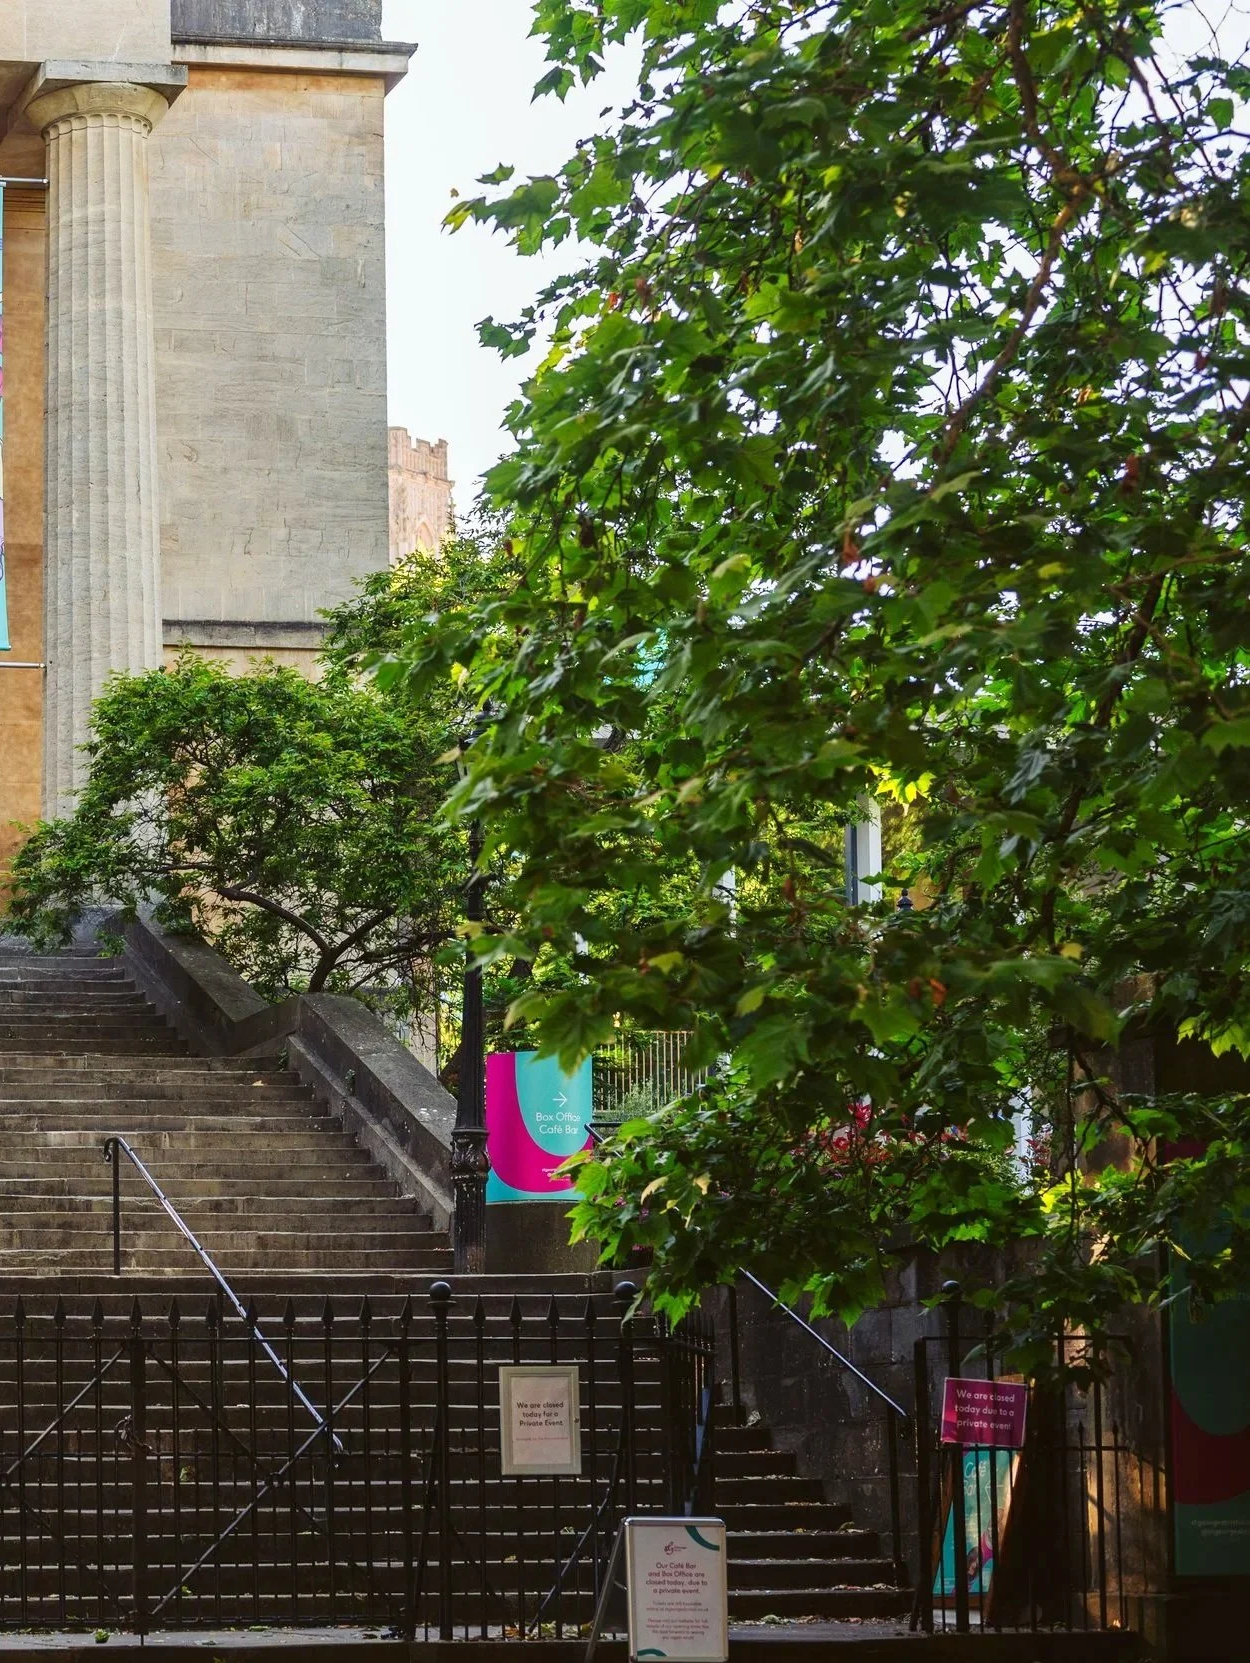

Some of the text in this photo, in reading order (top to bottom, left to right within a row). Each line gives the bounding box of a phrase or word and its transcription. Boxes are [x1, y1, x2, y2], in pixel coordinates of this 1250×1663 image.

[536, 1111, 581, 1122] Box Office
[539, 1124, 579, 1134] Café Bar
[956, 1389, 1015, 1402] We are closed
[543, 1401, 564, 1409] closed
[954, 1404, 981, 1415] today
[982, 1405, 998, 1414] due
[999, 1408, 1008, 1416] to
[522, 1411, 542, 1419] today
[956, 1419, 988, 1429] private
